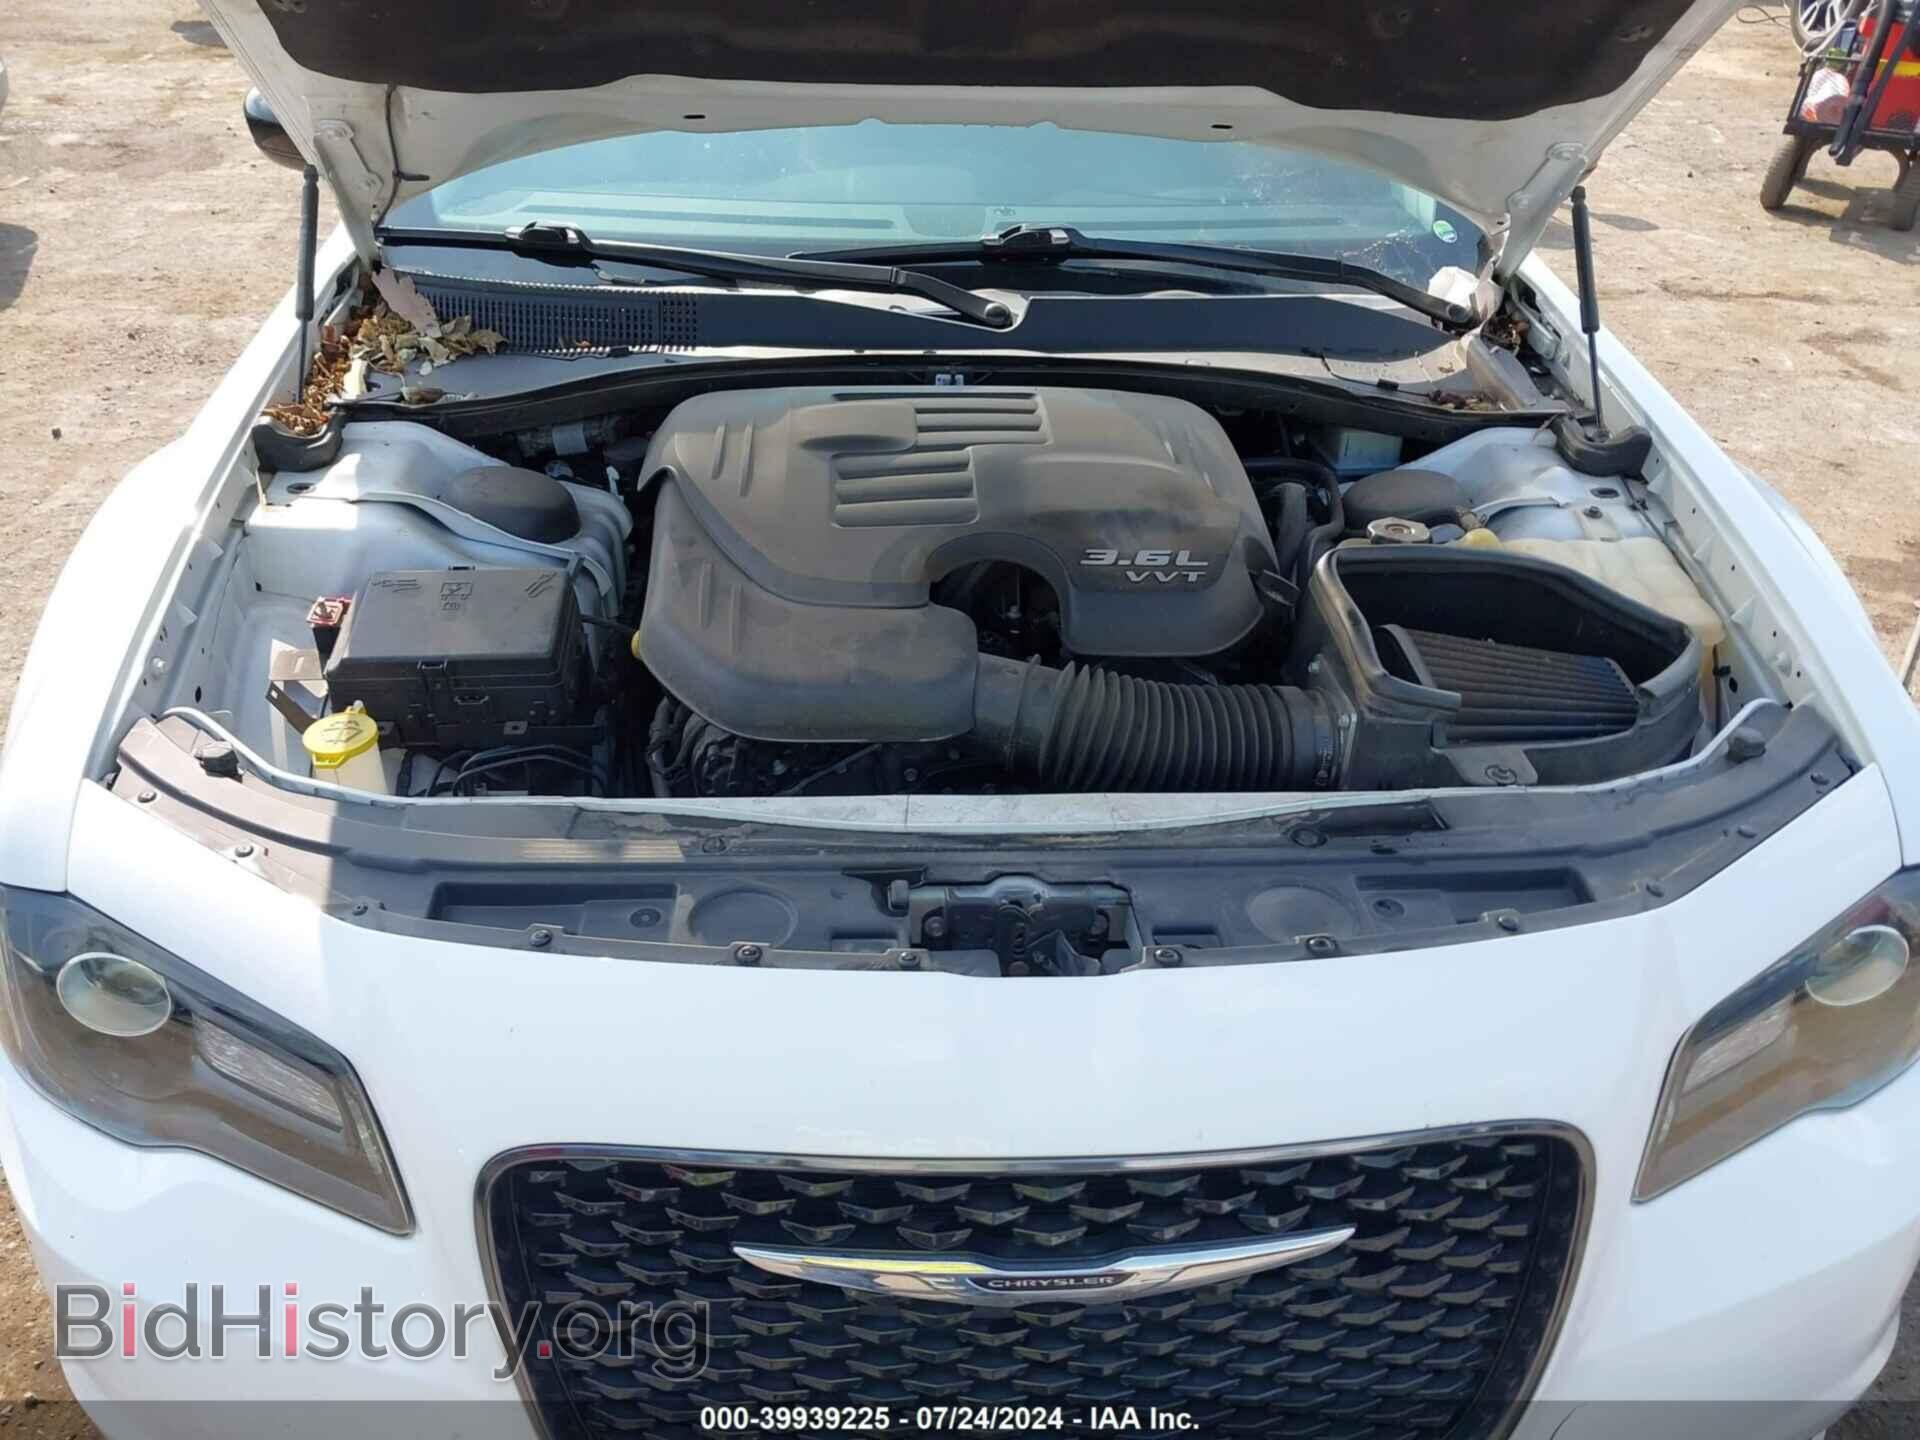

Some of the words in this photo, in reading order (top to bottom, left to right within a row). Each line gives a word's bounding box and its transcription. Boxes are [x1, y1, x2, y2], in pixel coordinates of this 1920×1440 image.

[1079, 548, 1209, 567] 3.6L
[1125, 570, 1207, 583] VVT
[987, 1276, 1114, 1288] CHRYSLER
